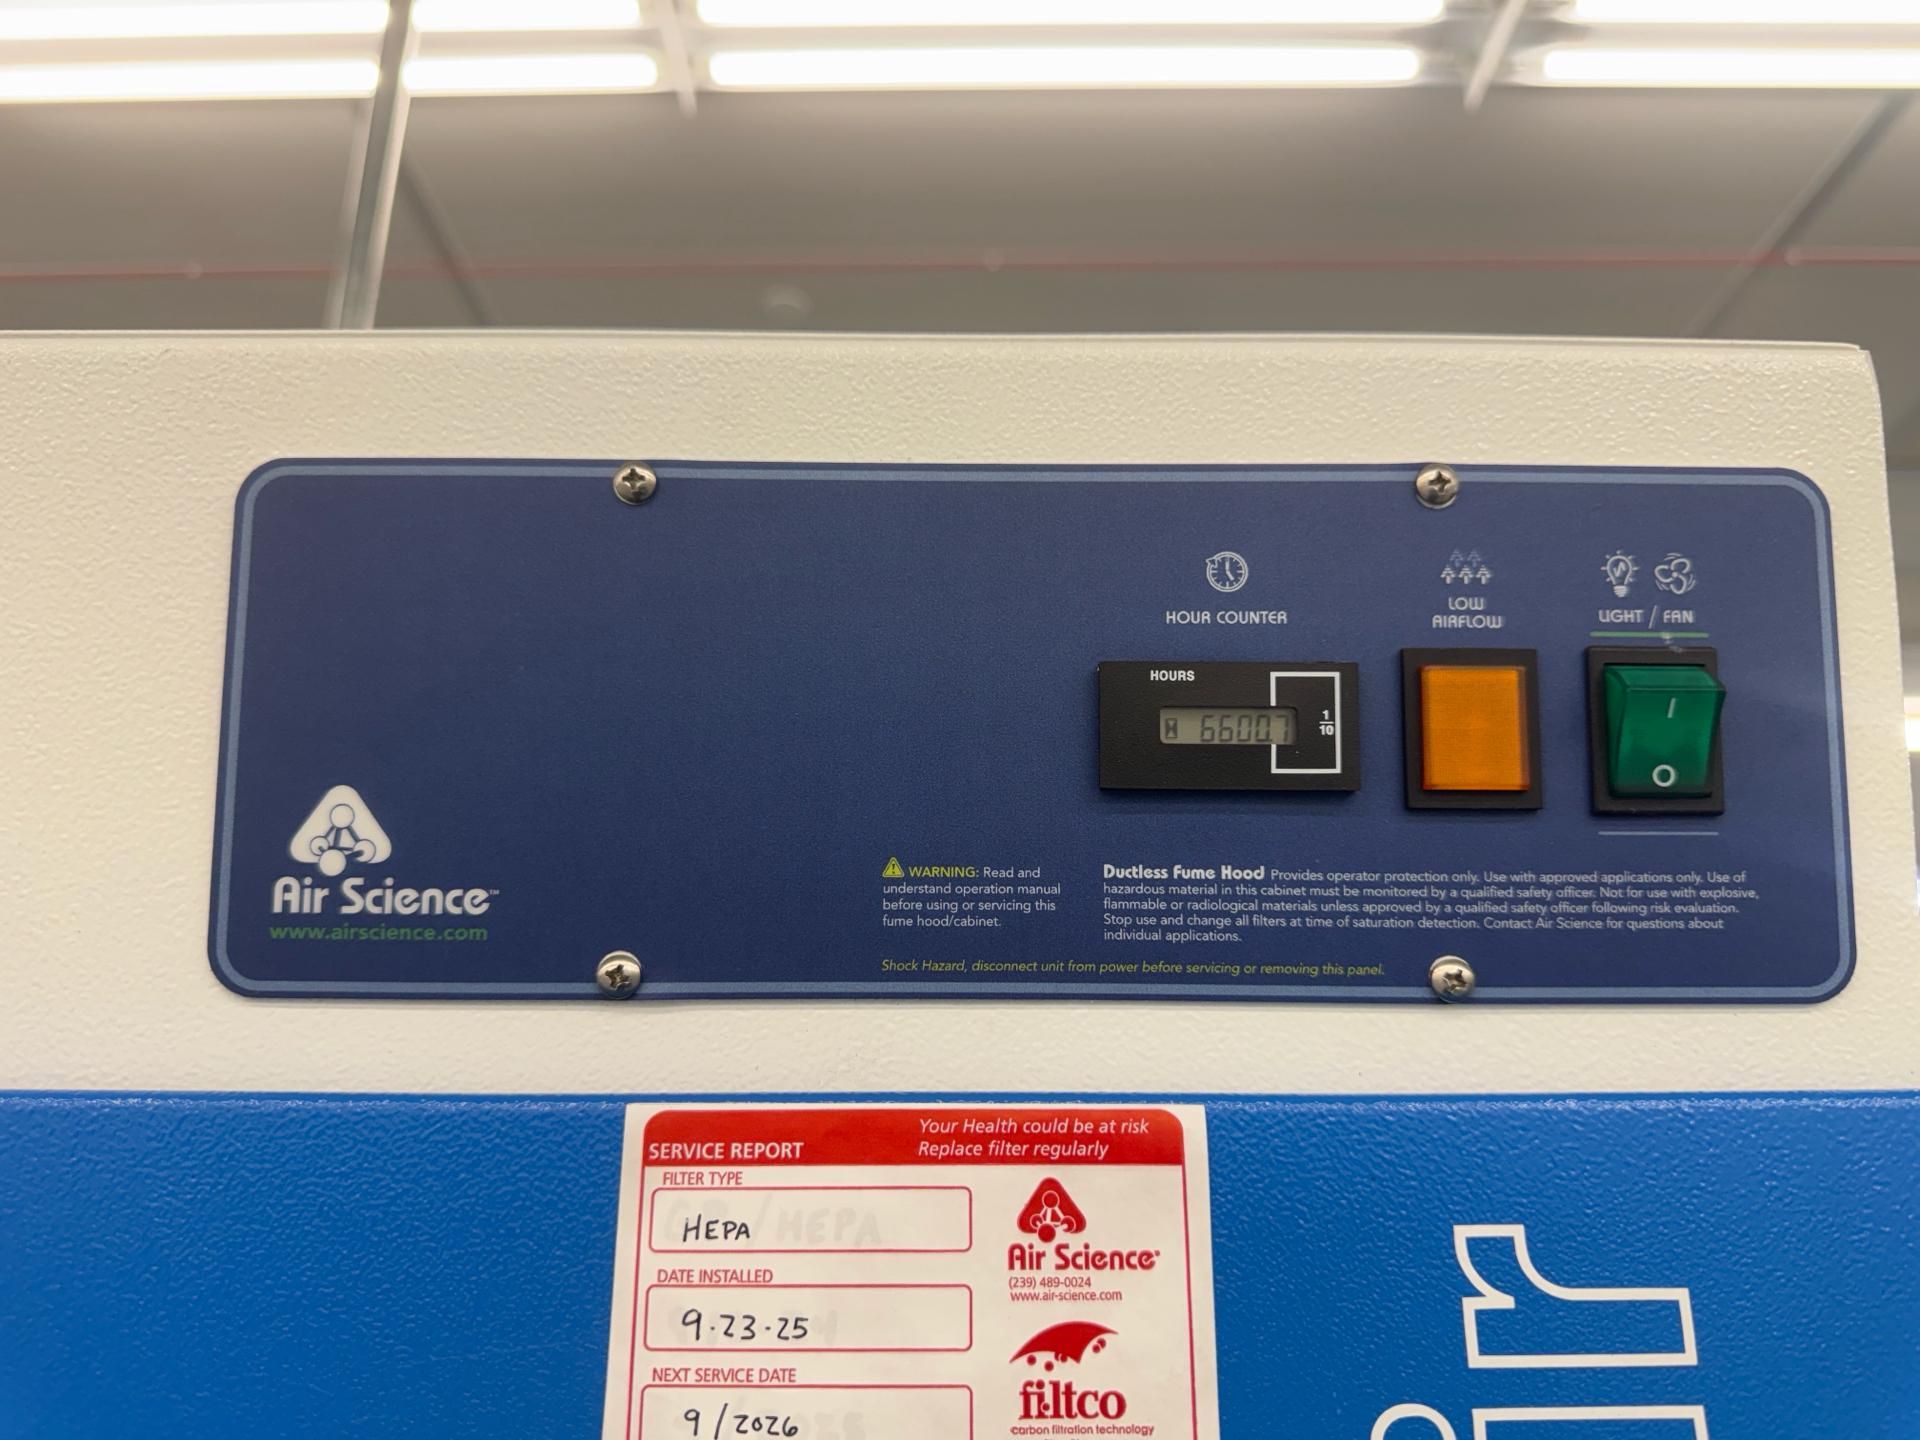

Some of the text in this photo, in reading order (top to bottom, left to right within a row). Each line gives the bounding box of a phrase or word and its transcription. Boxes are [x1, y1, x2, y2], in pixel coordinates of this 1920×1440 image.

[1448, 596, 1485, 611] LOW
[1165, 610, 1288, 625] HOUR COUNTER
[1431, 613, 1503, 629] AIRFLOW
[1598, 609, 1645, 623] LIGHT
[1663, 609, 1695, 624] FAN
[1150, 669, 1196, 682] HOURS
[908, 866, 1041, 879] WARNING: Read and
[1103, 864, 1266, 881] Ductless Fume Hood
[1270, 869, 1747, 887] Provides operator protection only. Use with approved applications only. Use of
[272, 875, 331, 914] Air
[882, 883, 1061, 900] understand operation manual
[1103, 881, 1760, 901] hazardous material in this cabinet must be monitored by a qualified safety officer. Not for use with explosive,
[882, 898, 1056, 917] before using or servicing this
[1103, 896, 1740, 917] flammable or radiological materials unless approved by a qualified safety officer following risk evaluation.
[882, 913, 914, 927] fume
[1103, 912, 1725, 933] Stop use and change all filters at time of saturation detection. Contact Air Science for questions about
[269, 922, 488, 941] www.airscience.com
[1103, 927, 1242, 945] individual applications.
[881, 958, 1385, 978] Shock Hazard, disconnect unit from power before servicing or removing this panel.
[919, 1117, 1150, 1134] Your Health could be at risk
[648, 1141, 805, 1160] SERVICE REPORT
[918, 1139, 1110, 1160] Replace filter regularly
[662, 1170, 743, 1186] FILTER TYPE
[682, 1212, 751, 1243] HEPA
[1007, 1243, 1161, 1271] Air Science
[656, 1268, 774, 1285] DATE INSTALLED
[1008, 1276, 1092, 1290] (239) 489-0024
[1009, 1290, 1123, 1302] www.air-science.com
[651, 1366, 797, 1384] NEXT SERVICE DATE
[1009, 1423, 1155, 1437] carbon filtration technology
